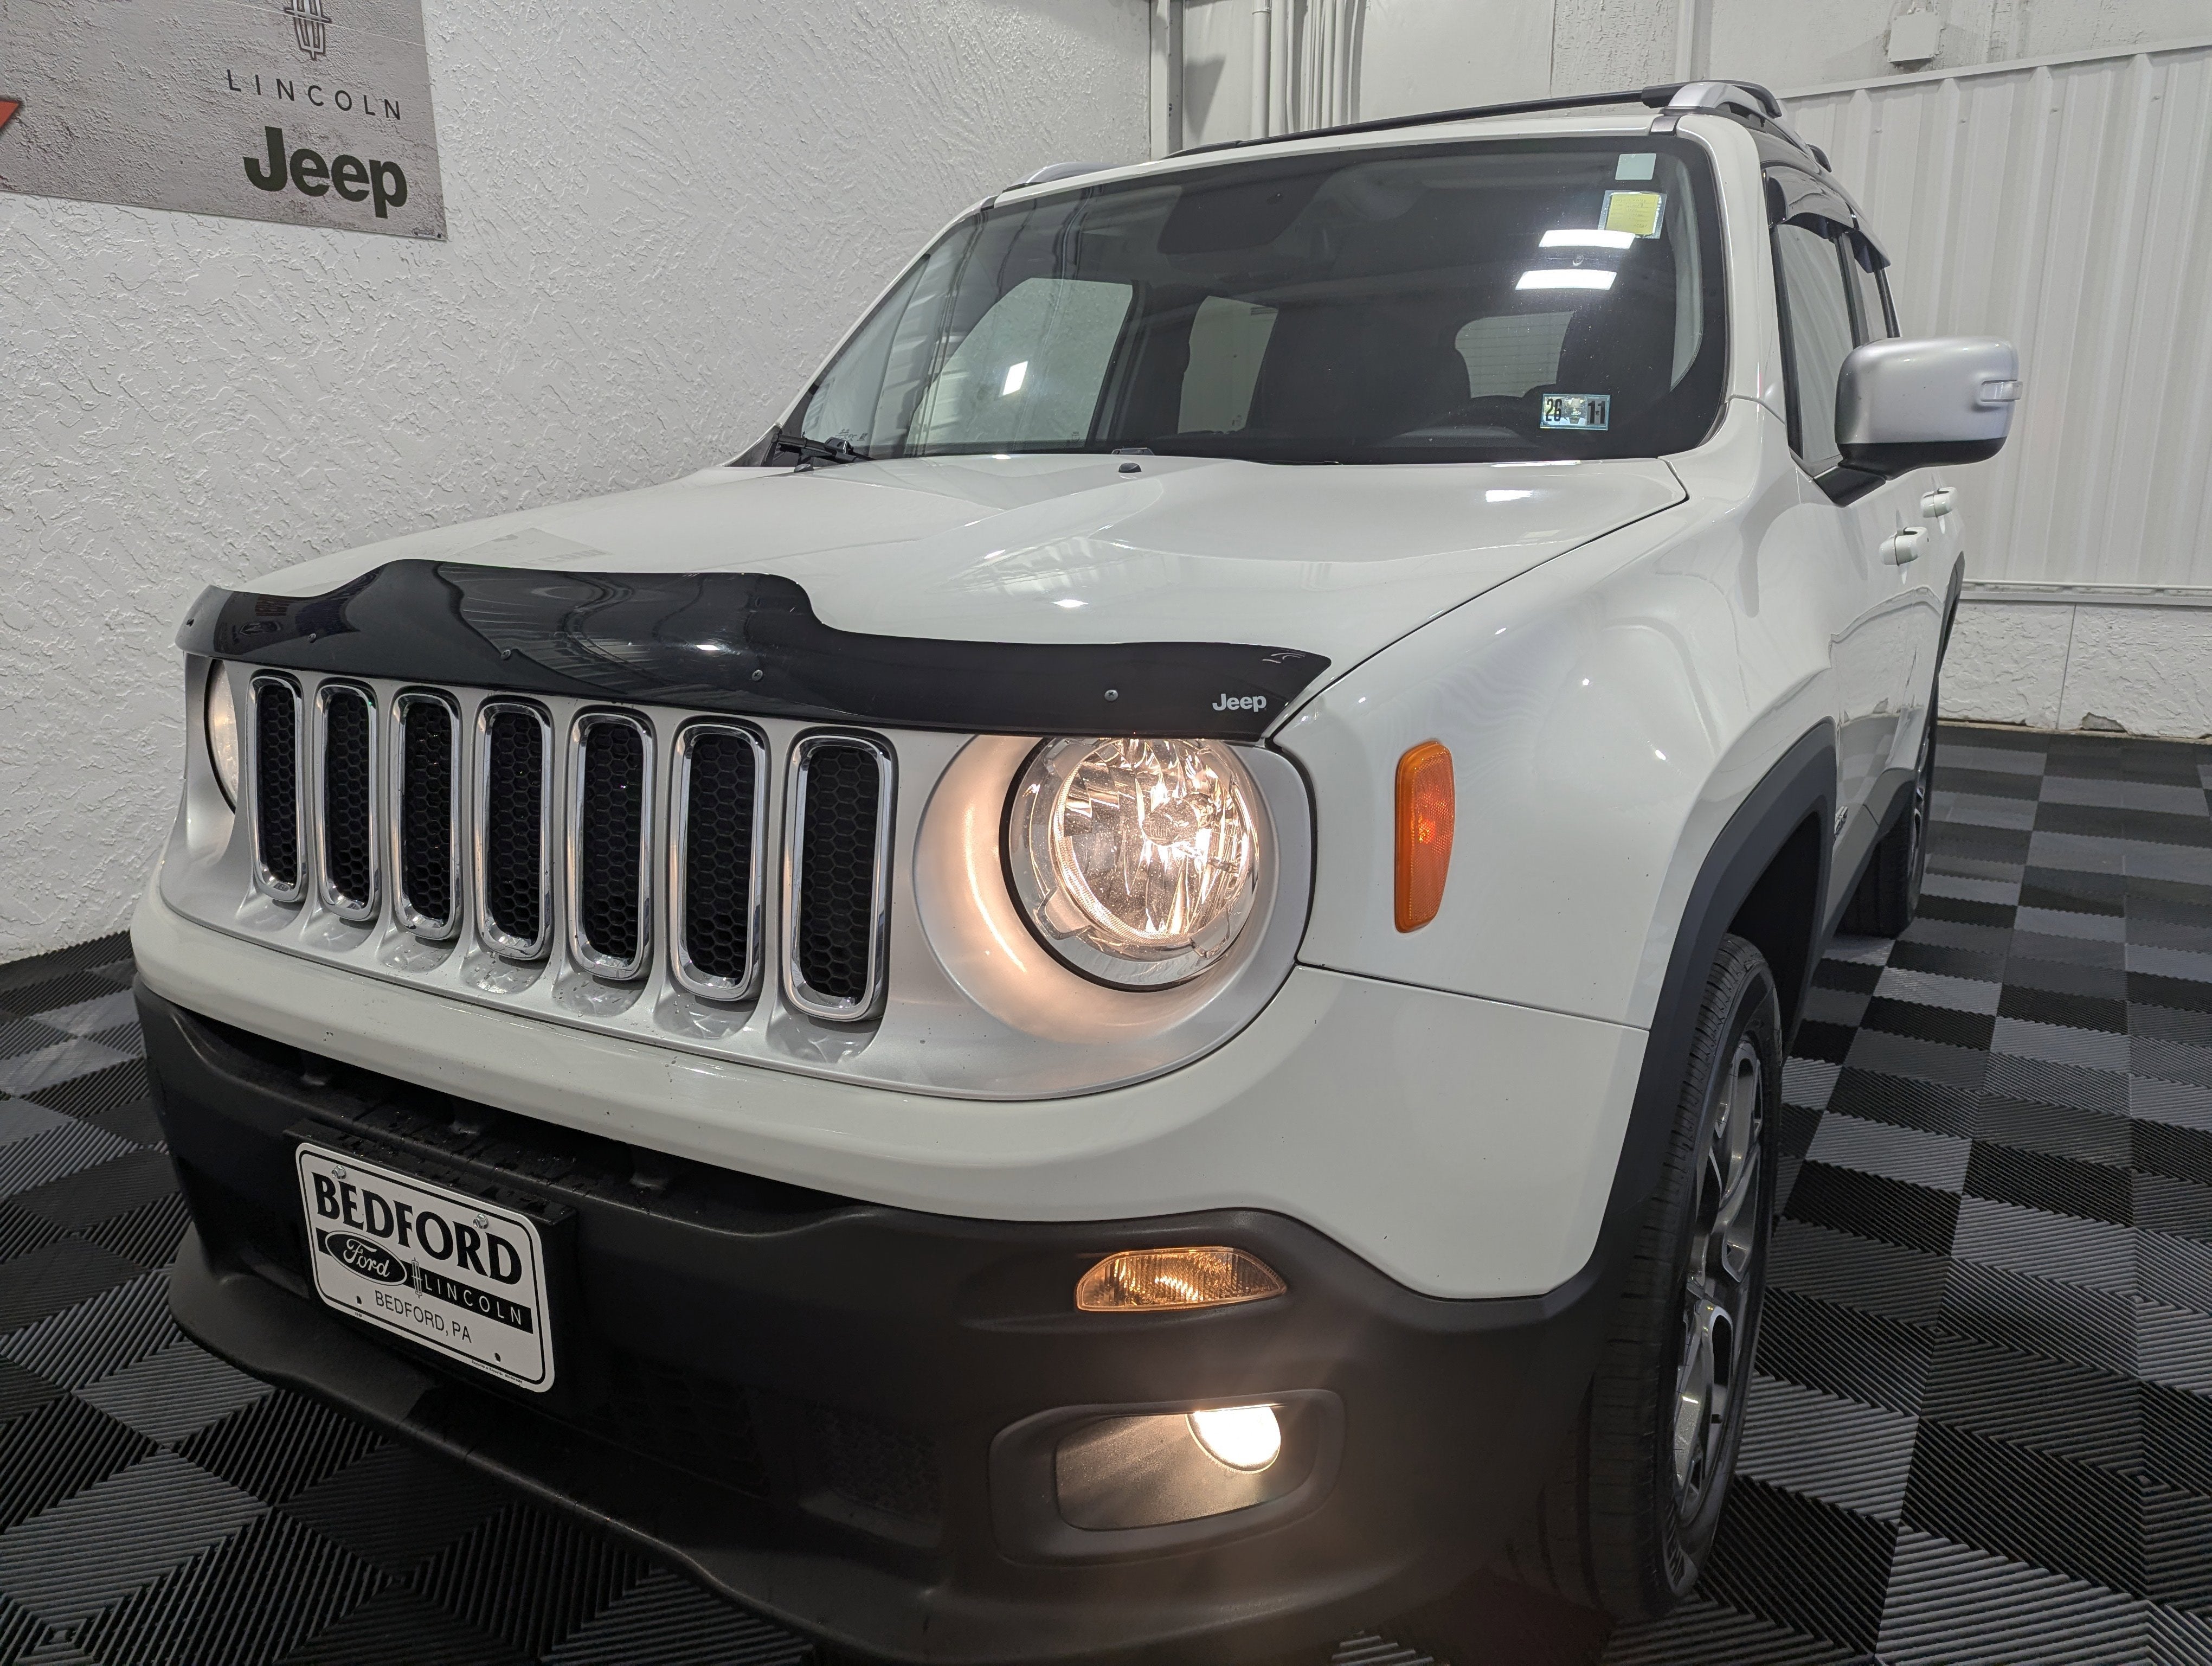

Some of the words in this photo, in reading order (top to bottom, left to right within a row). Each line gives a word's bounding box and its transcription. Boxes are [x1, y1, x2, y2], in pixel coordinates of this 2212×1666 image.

[227, 69, 401, 120] LINCOLN
[243, 126, 408, 219] Jeep
[1545, 399, 1562, 421] 26
[1588, 401, 1606, 424] 11
[1212, 694, 1266, 712] Jeep
[312, 1171, 522, 1285] BEDFORD
[343, 1239, 390, 1277] Ford
[425, 1276, 522, 1325] LINCOLN
[375, 1290, 449, 1336] BEDFORD,
[452, 1321, 472, 1344] PA
